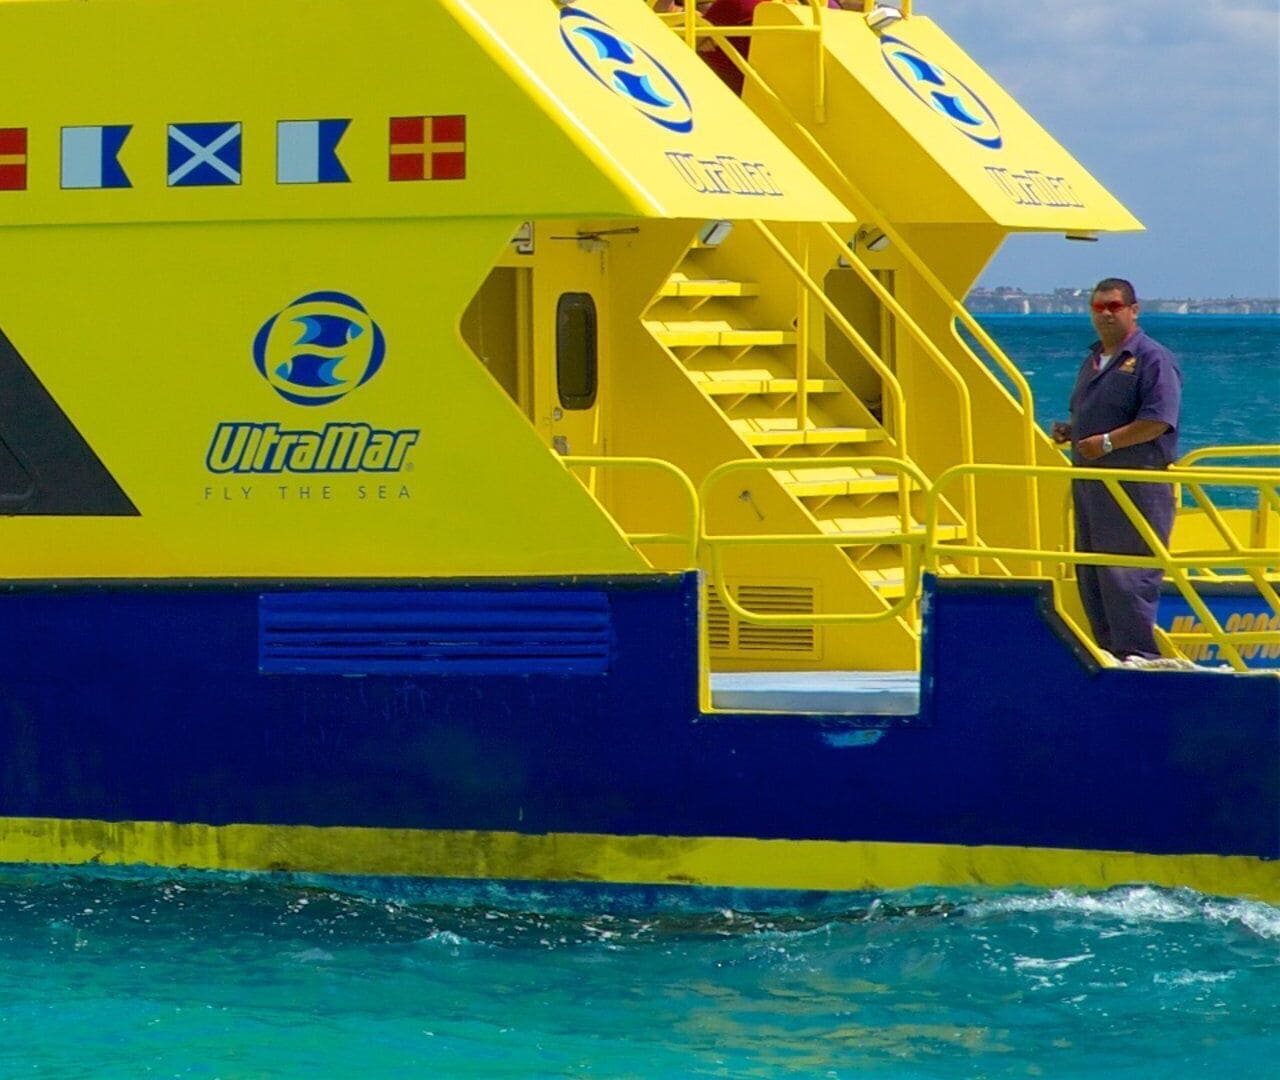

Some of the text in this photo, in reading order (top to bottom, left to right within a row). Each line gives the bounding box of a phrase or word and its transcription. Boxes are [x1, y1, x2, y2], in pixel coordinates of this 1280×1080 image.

[204, 484, 411, 500] FLY THE SEA
